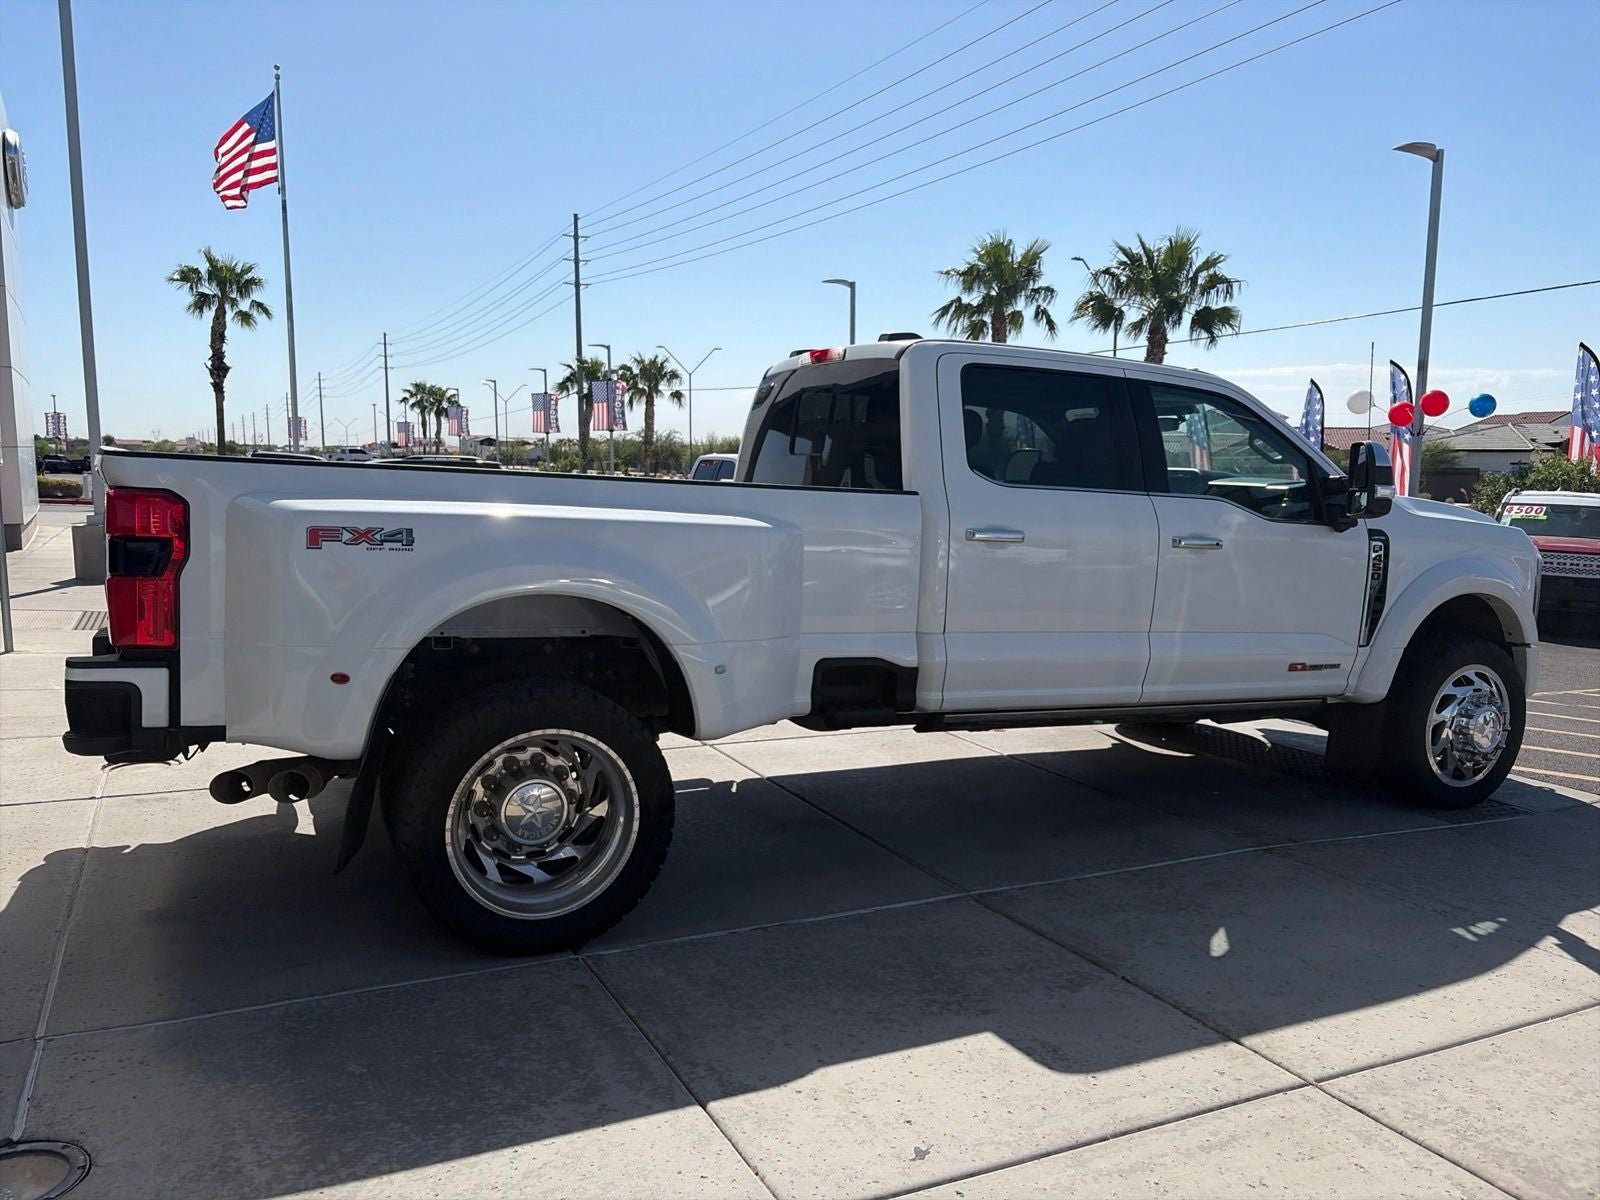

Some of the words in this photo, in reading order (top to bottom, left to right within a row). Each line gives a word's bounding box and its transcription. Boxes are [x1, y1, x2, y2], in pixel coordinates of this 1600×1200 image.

[1506, 505, 1544, 514] $500
[306, 525, 415, 549] FX4
[1544, 560, 1600, 568] RONC
